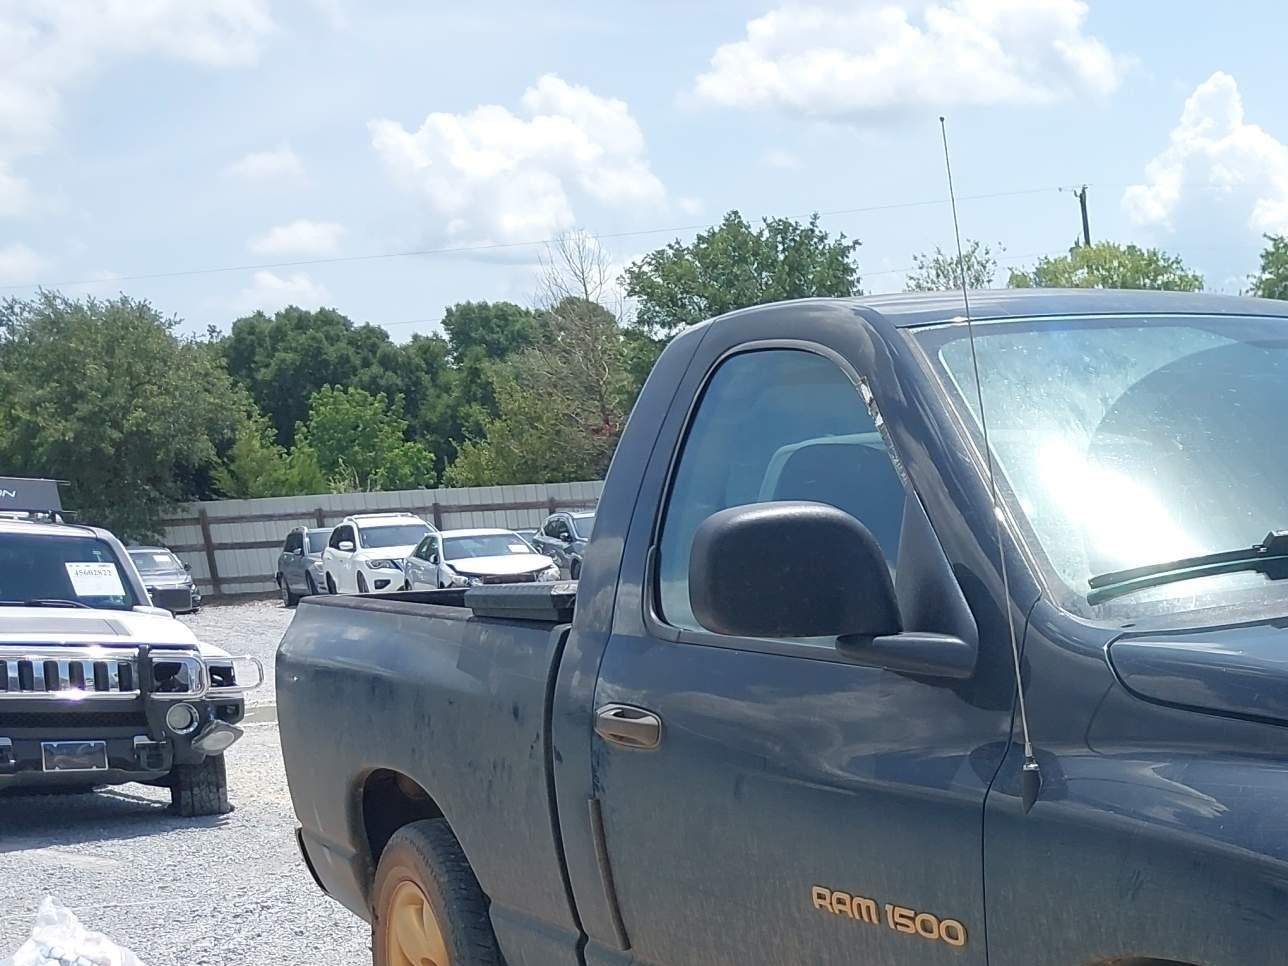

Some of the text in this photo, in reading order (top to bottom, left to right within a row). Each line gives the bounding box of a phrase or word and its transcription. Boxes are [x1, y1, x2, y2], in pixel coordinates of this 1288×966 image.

[0, 489, 16, 498] N
[812, 885, 969, 947] RAM 1500
